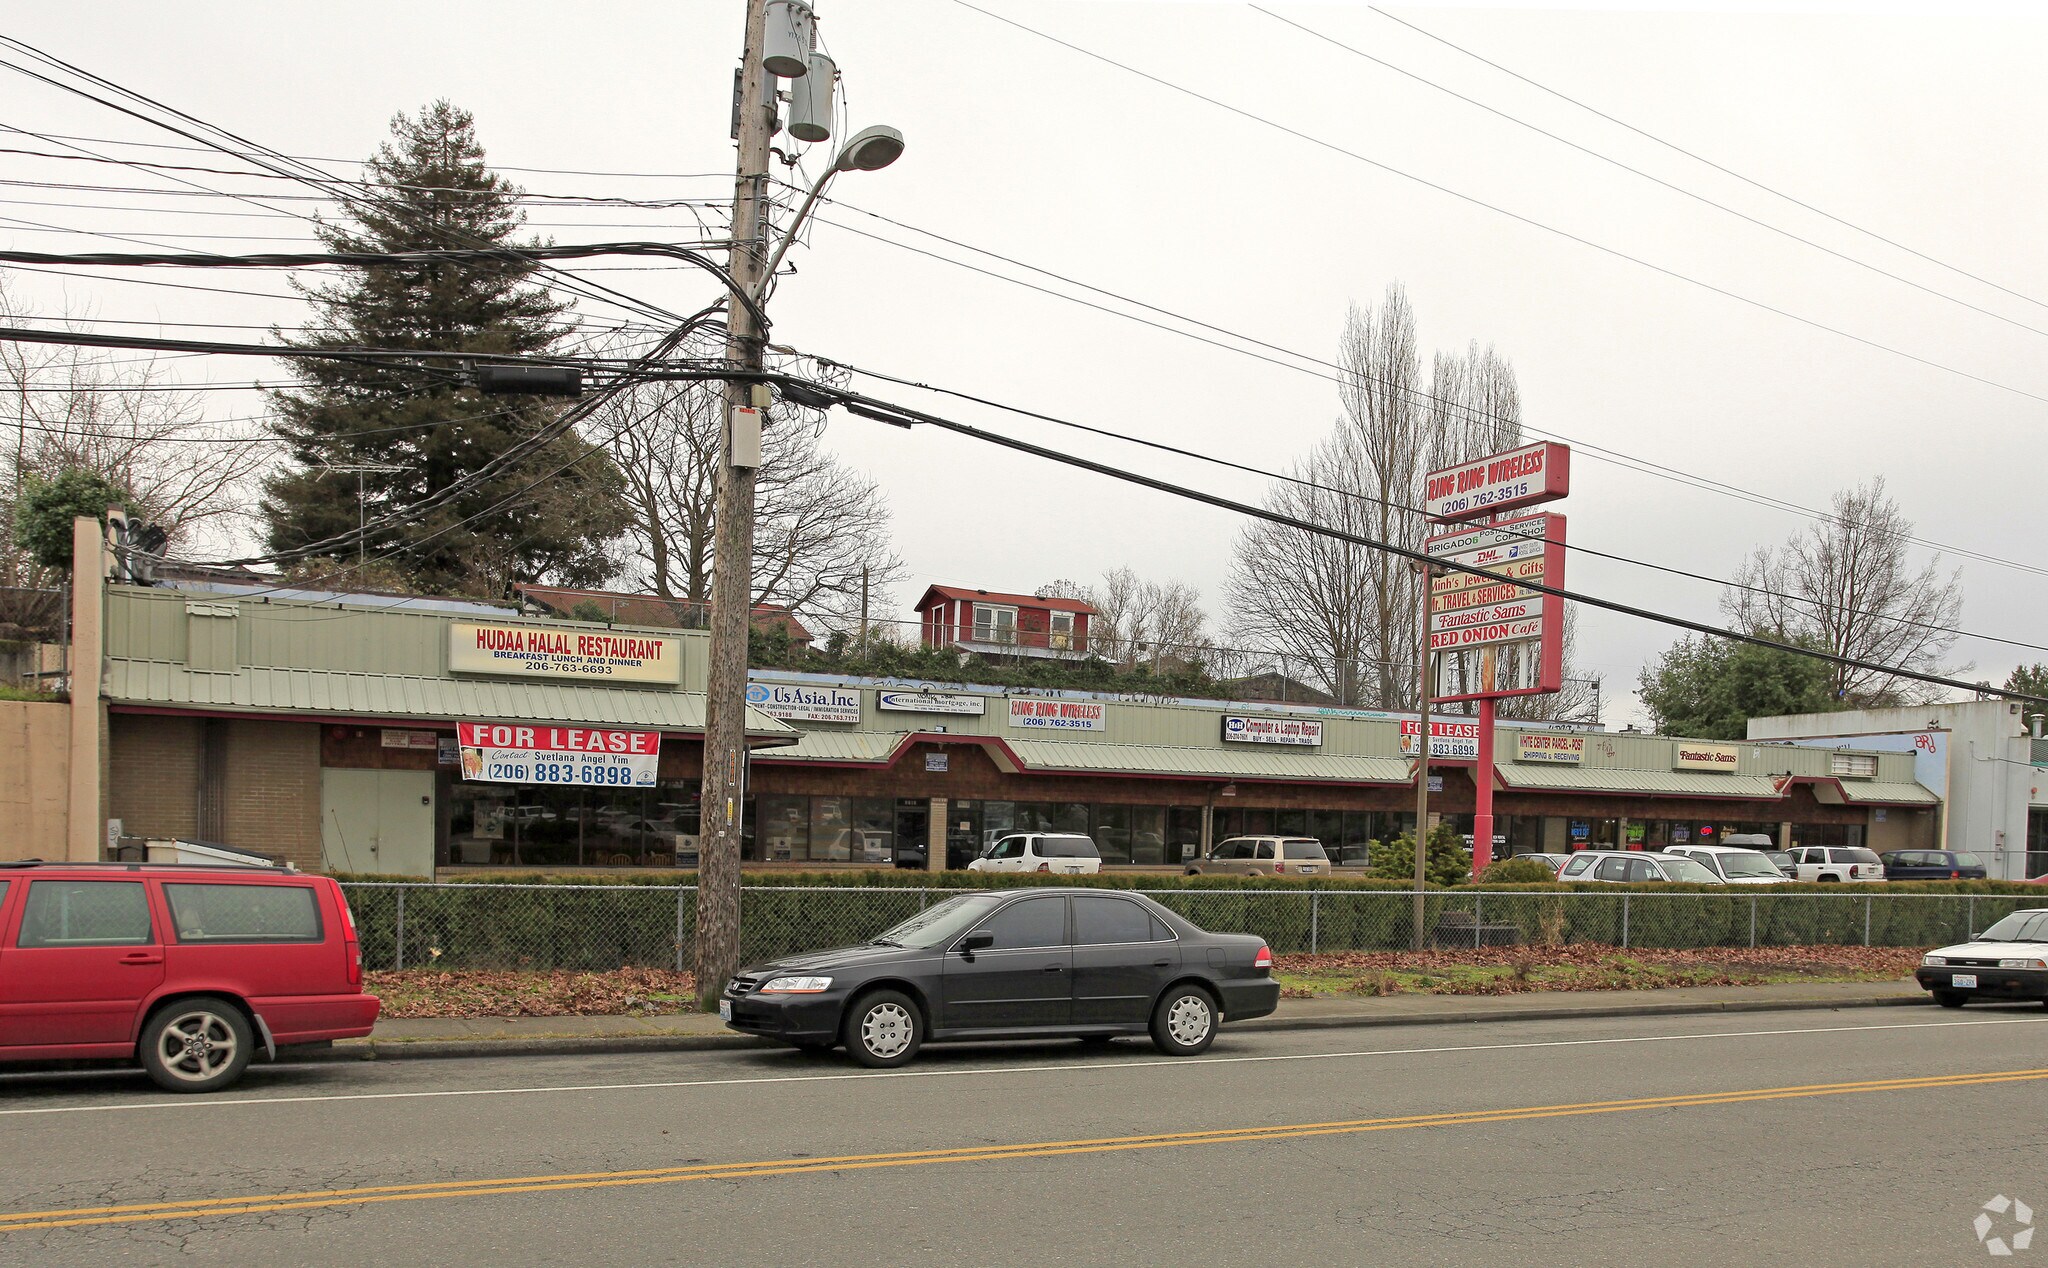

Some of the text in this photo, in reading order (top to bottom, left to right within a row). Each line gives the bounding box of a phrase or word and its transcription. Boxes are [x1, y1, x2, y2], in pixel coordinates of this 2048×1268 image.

[1428, 449, 1544, 501] RING RING WIRELESS
[1441, 482, 1528, 516] (206) 762-3515
[1506, 566, 1514, 578] &
[1520, 562, 1544, 576] Gifts
[1443, 591, 1471, 610] TRAVEL
[1472, 594, 1476, 603] &
[1478, 584, 1516, 604] SERVICES
[1438, 604, 1526, 628] Fantastic Sams
[1431, 621, 1538, 648] RED ONION Café
[476, 628, 662, 660] HUDAA HALAL RESTAURANT
[494, 650, 642, 667] BREAKFAST LUNCH AND DINNER
[525, 661, 612, 675] 206-763-6693
[1011, 700, 1102, 719] RING RING WIRELESS
[1023, 718, 1092, 728] (206) 762-3515
[1246, 718, 1274, 735] Computer
[1275, 723, 1279, 734] &
[1280, 720, 1300, 737] Laptop
[1302, 722, 1320, 738] Repair
[1439, 724, 1479, 737] LEASE
[473, 724, 646, 752] FOR LEASE
[1520, 735, 1533, 748] WHITE
[1534, 736, 1551, 749] CENTER
[534, 752, 574, 762] Svetlana
[580, 754, 606, 764] Angel
[612, 754, 628, 764] Yim
[1412, 743, 1474, 756] (2) 883-6898
[1524, 751, 1546, 760] SHIPPING
[1554, 752, 1580, 760] RECEIVING
[1680, 750, 1736, 762] Fantastic Sams
[488, 764, 529, 780] (206)
[535, 763, 632, 785] 883-6898
